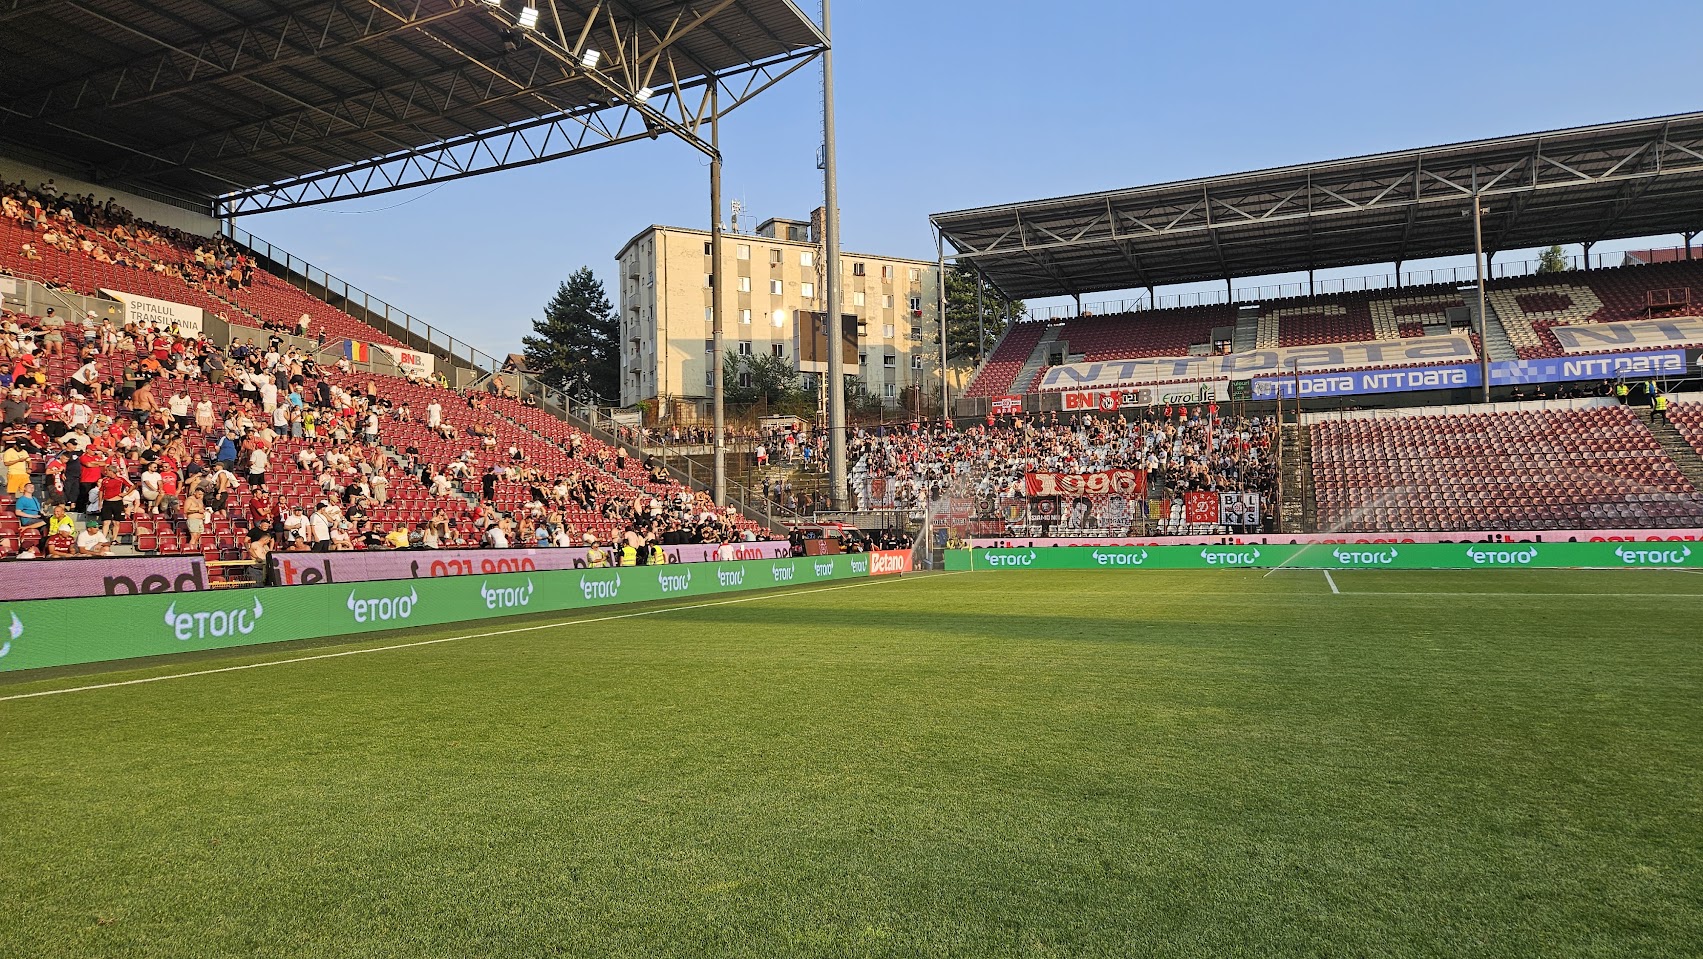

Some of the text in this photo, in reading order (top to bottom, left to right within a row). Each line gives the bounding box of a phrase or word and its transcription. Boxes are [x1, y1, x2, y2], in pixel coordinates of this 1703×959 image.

[131, 301, 175, 317] SPITALUL
[131, 311, 198, 330] TRANSILVANIA
[1555, 317, 1703, 347] NT
[1044, 357, 1207, 385] NTT
[1564, 358, 1612, 377] NTT
[1254, 380, 1295, 395] TT
[1363, 373, 1405, 389] NTT
[1035, 471, 1136, 496] 1996
[871, 553, 904, 573] Betano
